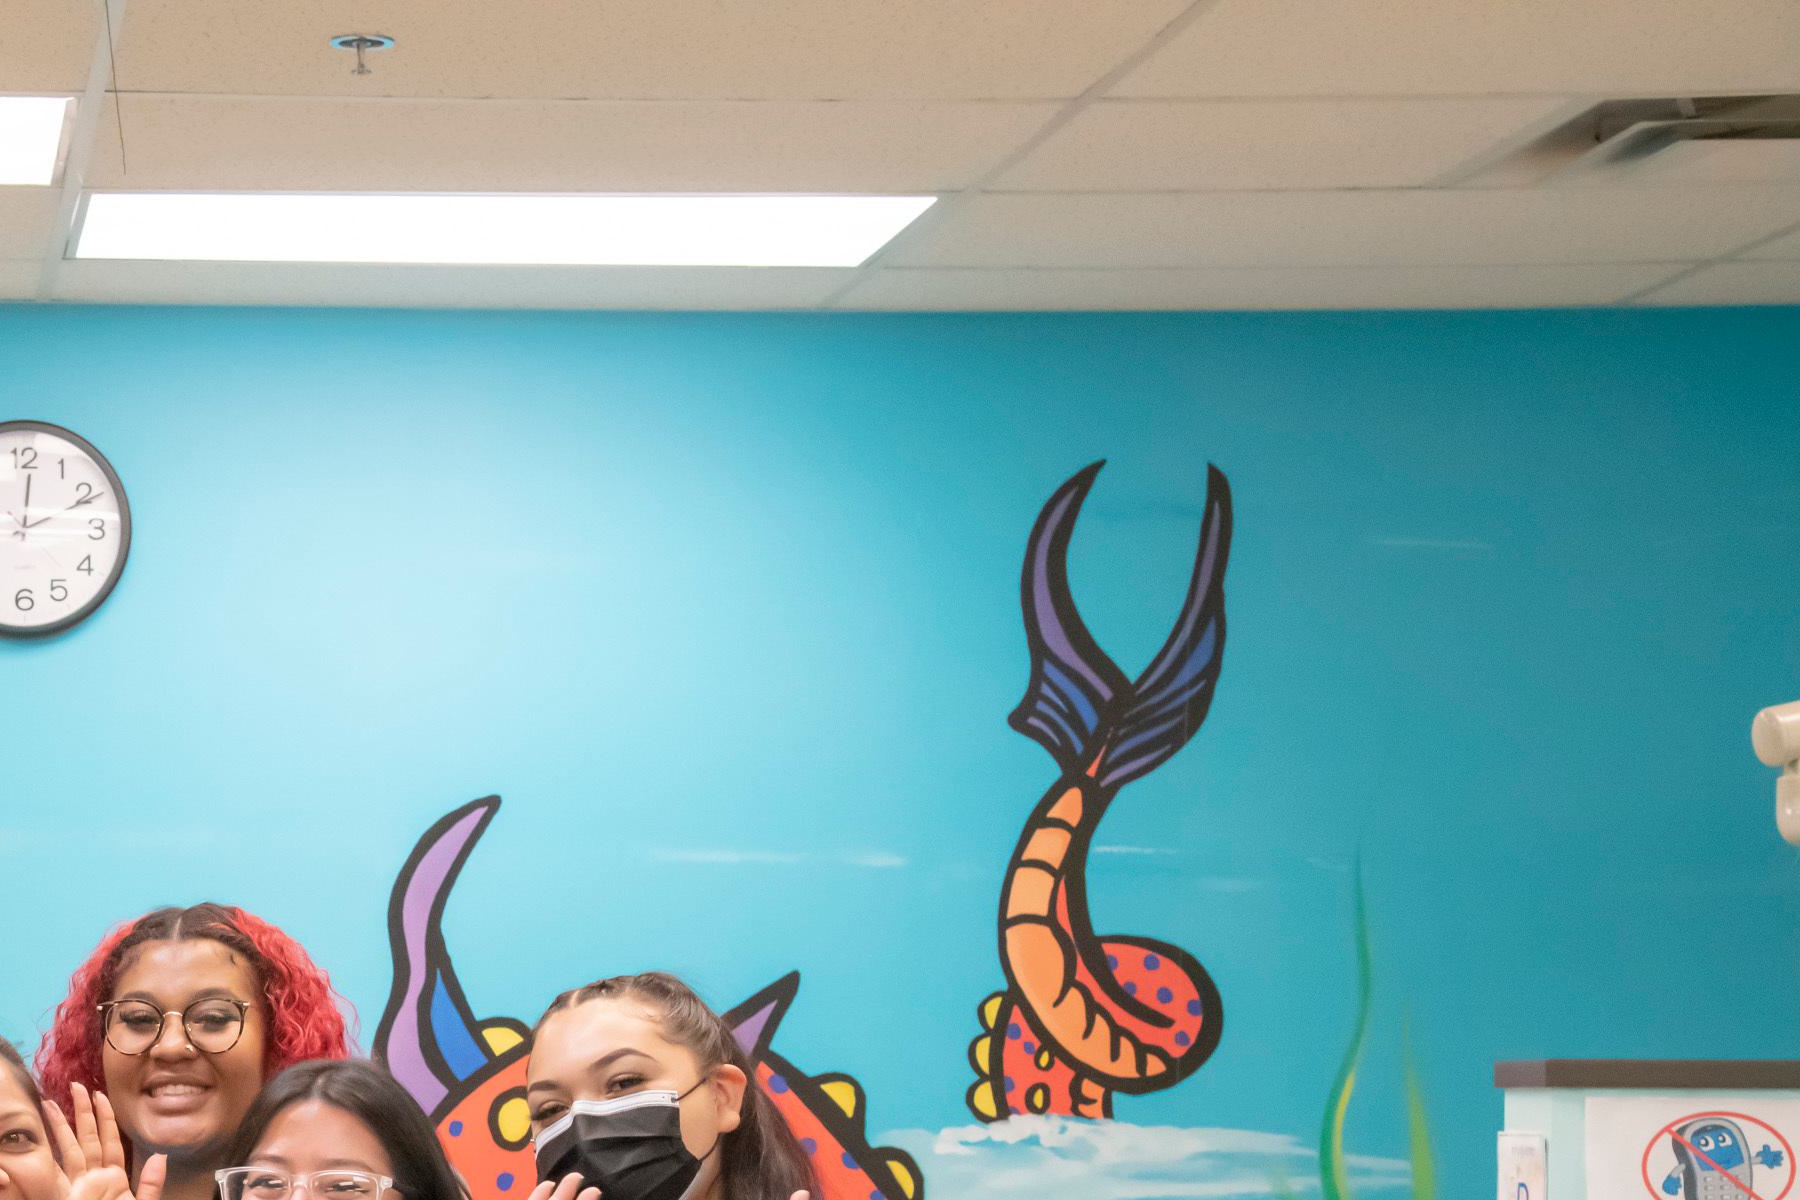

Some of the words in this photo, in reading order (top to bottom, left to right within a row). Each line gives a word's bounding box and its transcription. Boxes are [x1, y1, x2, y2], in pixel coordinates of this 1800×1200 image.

[11, 447, 38, 469] 12
[58, 458, 64, 480] 1
[75, 482, 93, 504] 2
[88, 518, 105, 540] 3
[76, 554, 94, 576] 4
[15, 588, 35, 611] 6
[50, 579, 68, 602] 5
